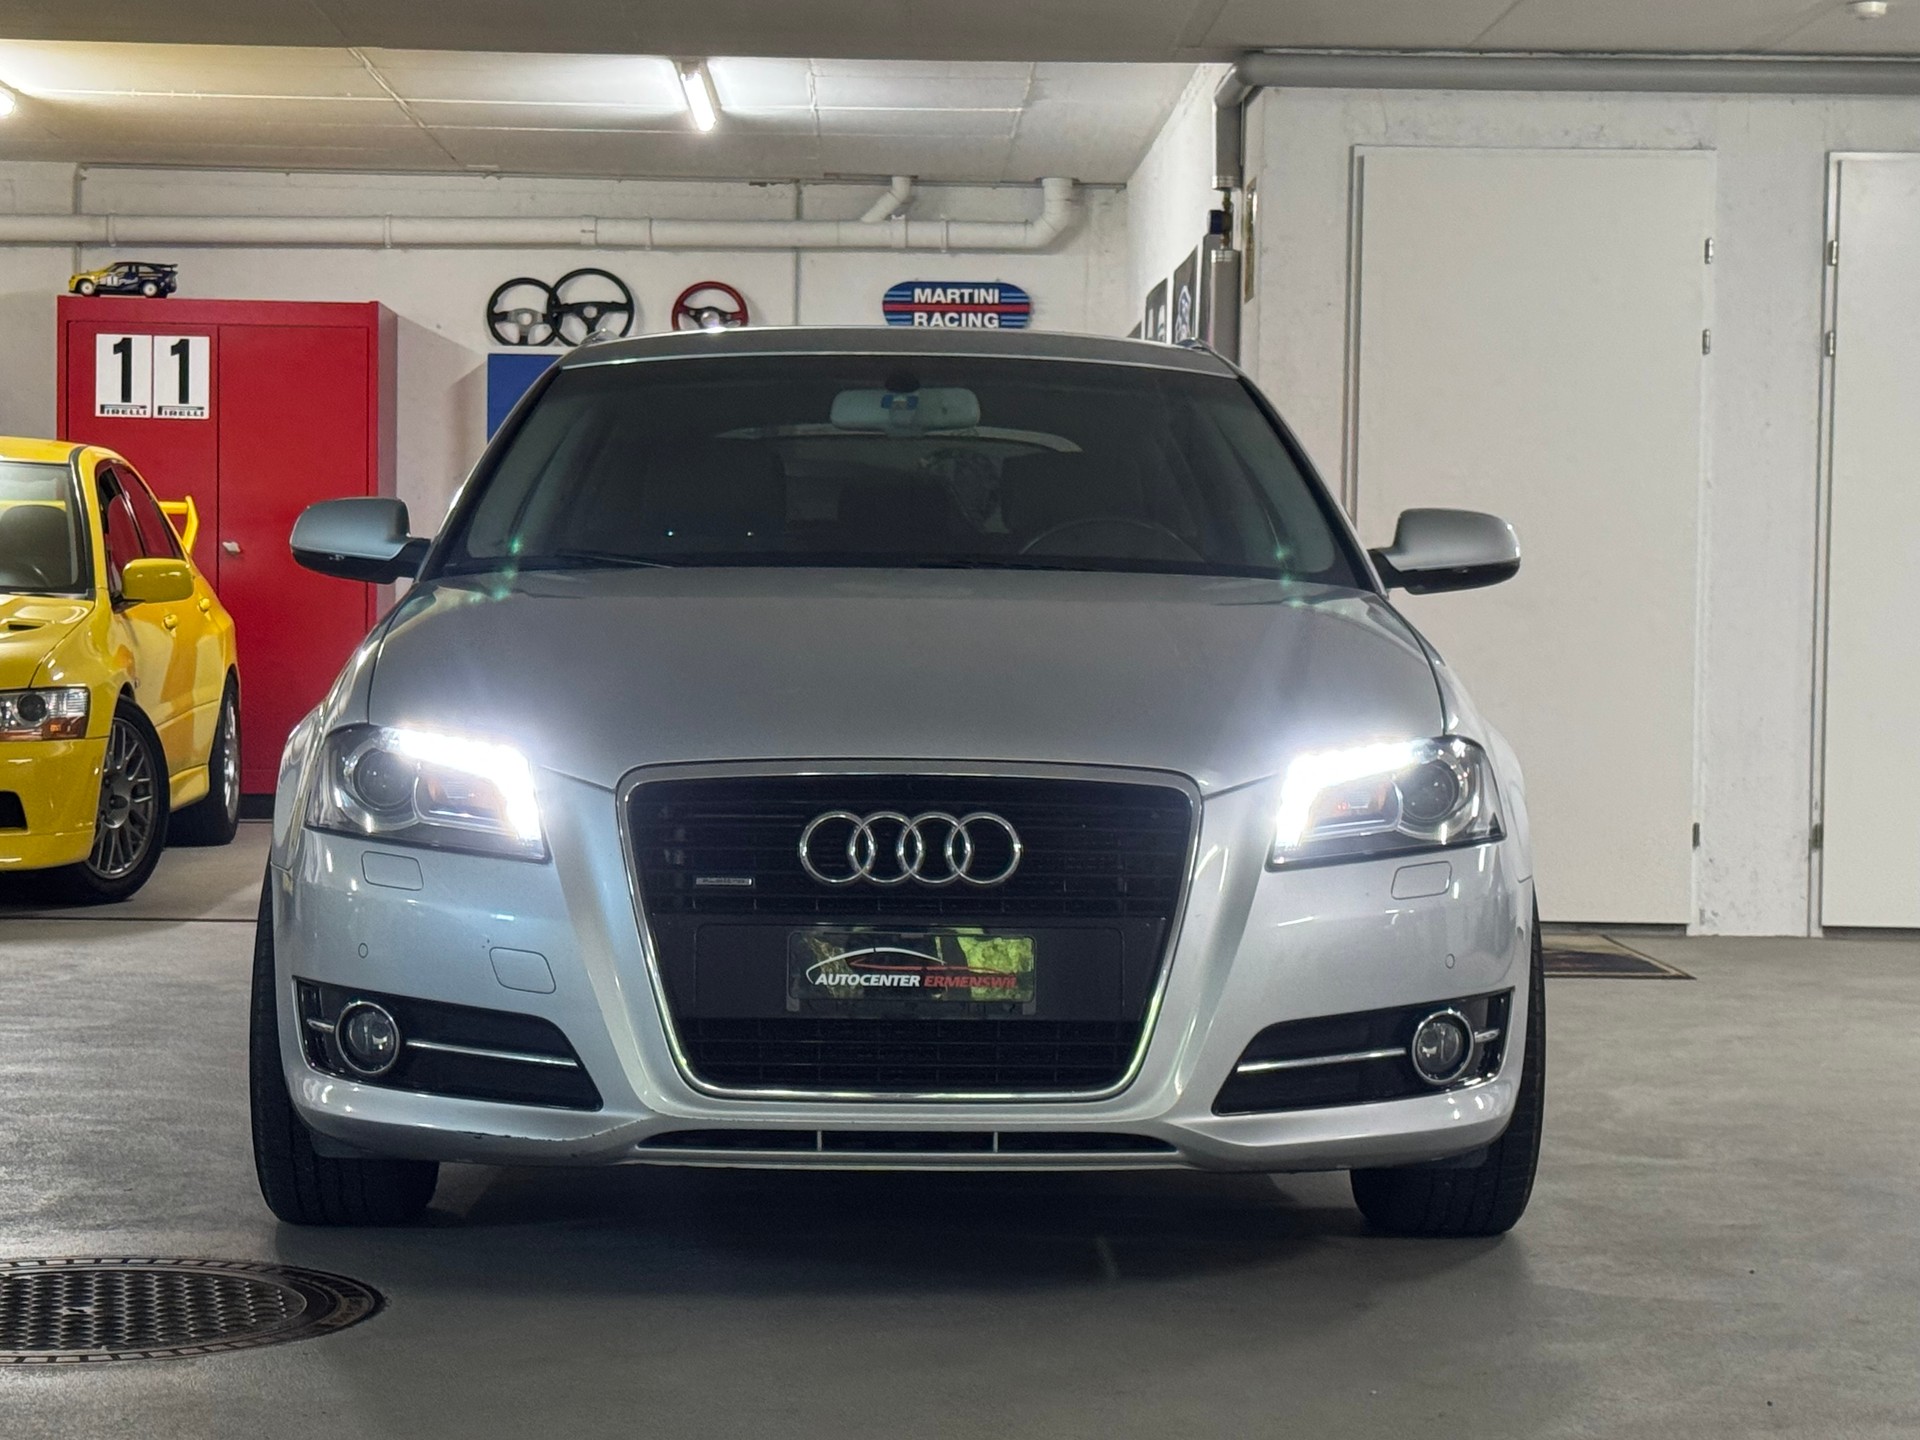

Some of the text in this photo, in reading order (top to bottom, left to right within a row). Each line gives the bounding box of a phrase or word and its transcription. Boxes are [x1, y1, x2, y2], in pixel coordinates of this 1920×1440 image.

[914, 288, 999, 304] MARTINI
[914, 312, 999, 328] RACING
[816, 973, 920, 987] AUTOCENTER
